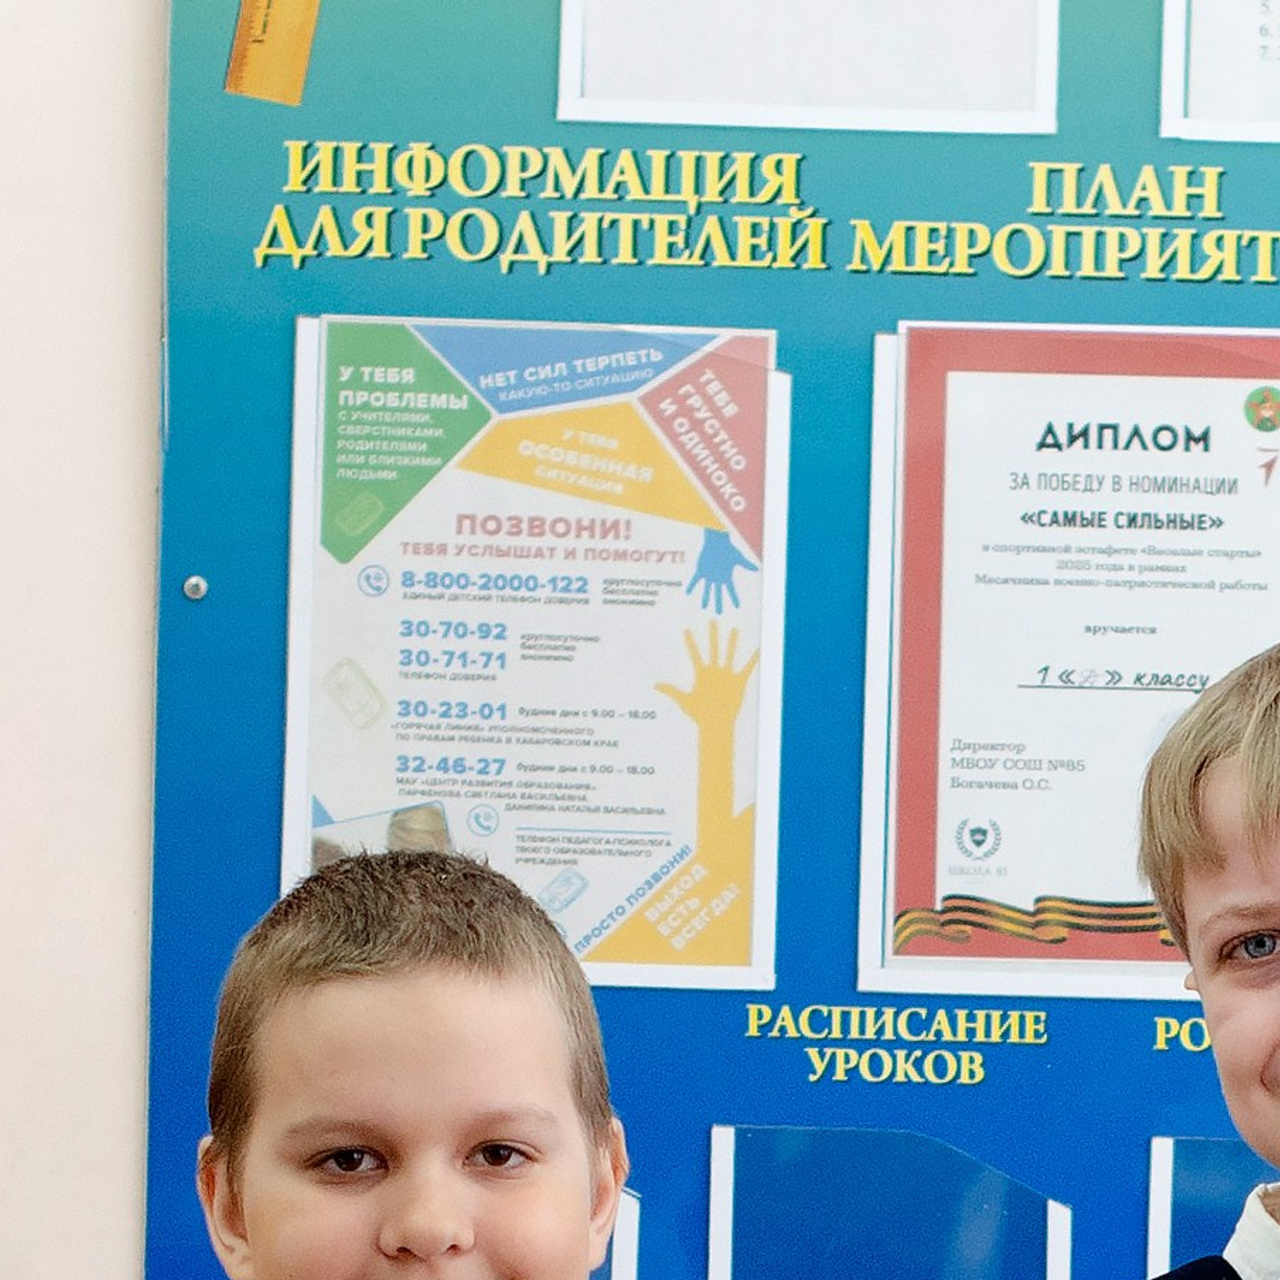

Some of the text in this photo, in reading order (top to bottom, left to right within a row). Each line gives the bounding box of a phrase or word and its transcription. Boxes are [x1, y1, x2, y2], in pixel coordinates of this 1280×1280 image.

[283, 140, 803, 212] ИНФОРМАЦИЯ
[1027, 161, 1226, 220] ПЛАН
[254, 204, 830, 275] ДЛЯ РОДИТЕЛЕЙ
[339, 366, 415, 384] У ТЕБЯ
[479, 348, 664, 389] НЕТ СИЛ ТЕРПЕТЬ
[338, 390, 468, 410] ПРОБЛЕМЫ
[699, 369, 739, 418] ТЕБЕ
[678, 384, 747, 471] ГРУСТНО
[1036, 420, 1212, 452] ДИПЛОМ
[519, 440, 655, 482] ОСОБЕННАЯ
[659, 398, 746, 511] И ОДИНОКО
[1008, 471, 1239, 497] ЗА ПОБЕДУ В НОМИНАЦИИ
[455, 513, 633, 540] ПОЗВОНИ!
[1020, 509, 1225, 531] «САМЫЕ СИЛЬНЫЕ»
[399, 541, 686, 564] ТЕБЯ УСЛЫШАТ И ПОМОГУТ!
[401, 570, 590, 594] 8-800-2000-122
[399, 620, 508, 641] 30-70-92
[1084, 624, 1157, 636] вручается
[399, 649, 507, 670] 30-71-71
[1036, 665, 1211, 695] 1 классу
[397, 700, 508, 720] 30-23-01
[950, 738, 1027, 755] Директор
[395, 755, 507, 776] 32-46-27
[949, 757, 1086, 772] МБОУ СОШ №85
[950, 776, 1053, 791] Богачева О.С.
[574, 844, 692, 954] ПРОСТО ПОЗВОНИ!
[643, 863, 708, 925] ВЫХОД
[656, 896, 701, 938] ЕСТЬ
[745, 1003, 1048, 1046] РАСПИСАНИЕ
[803, 1047, 986, 1085] УРОКОВ
